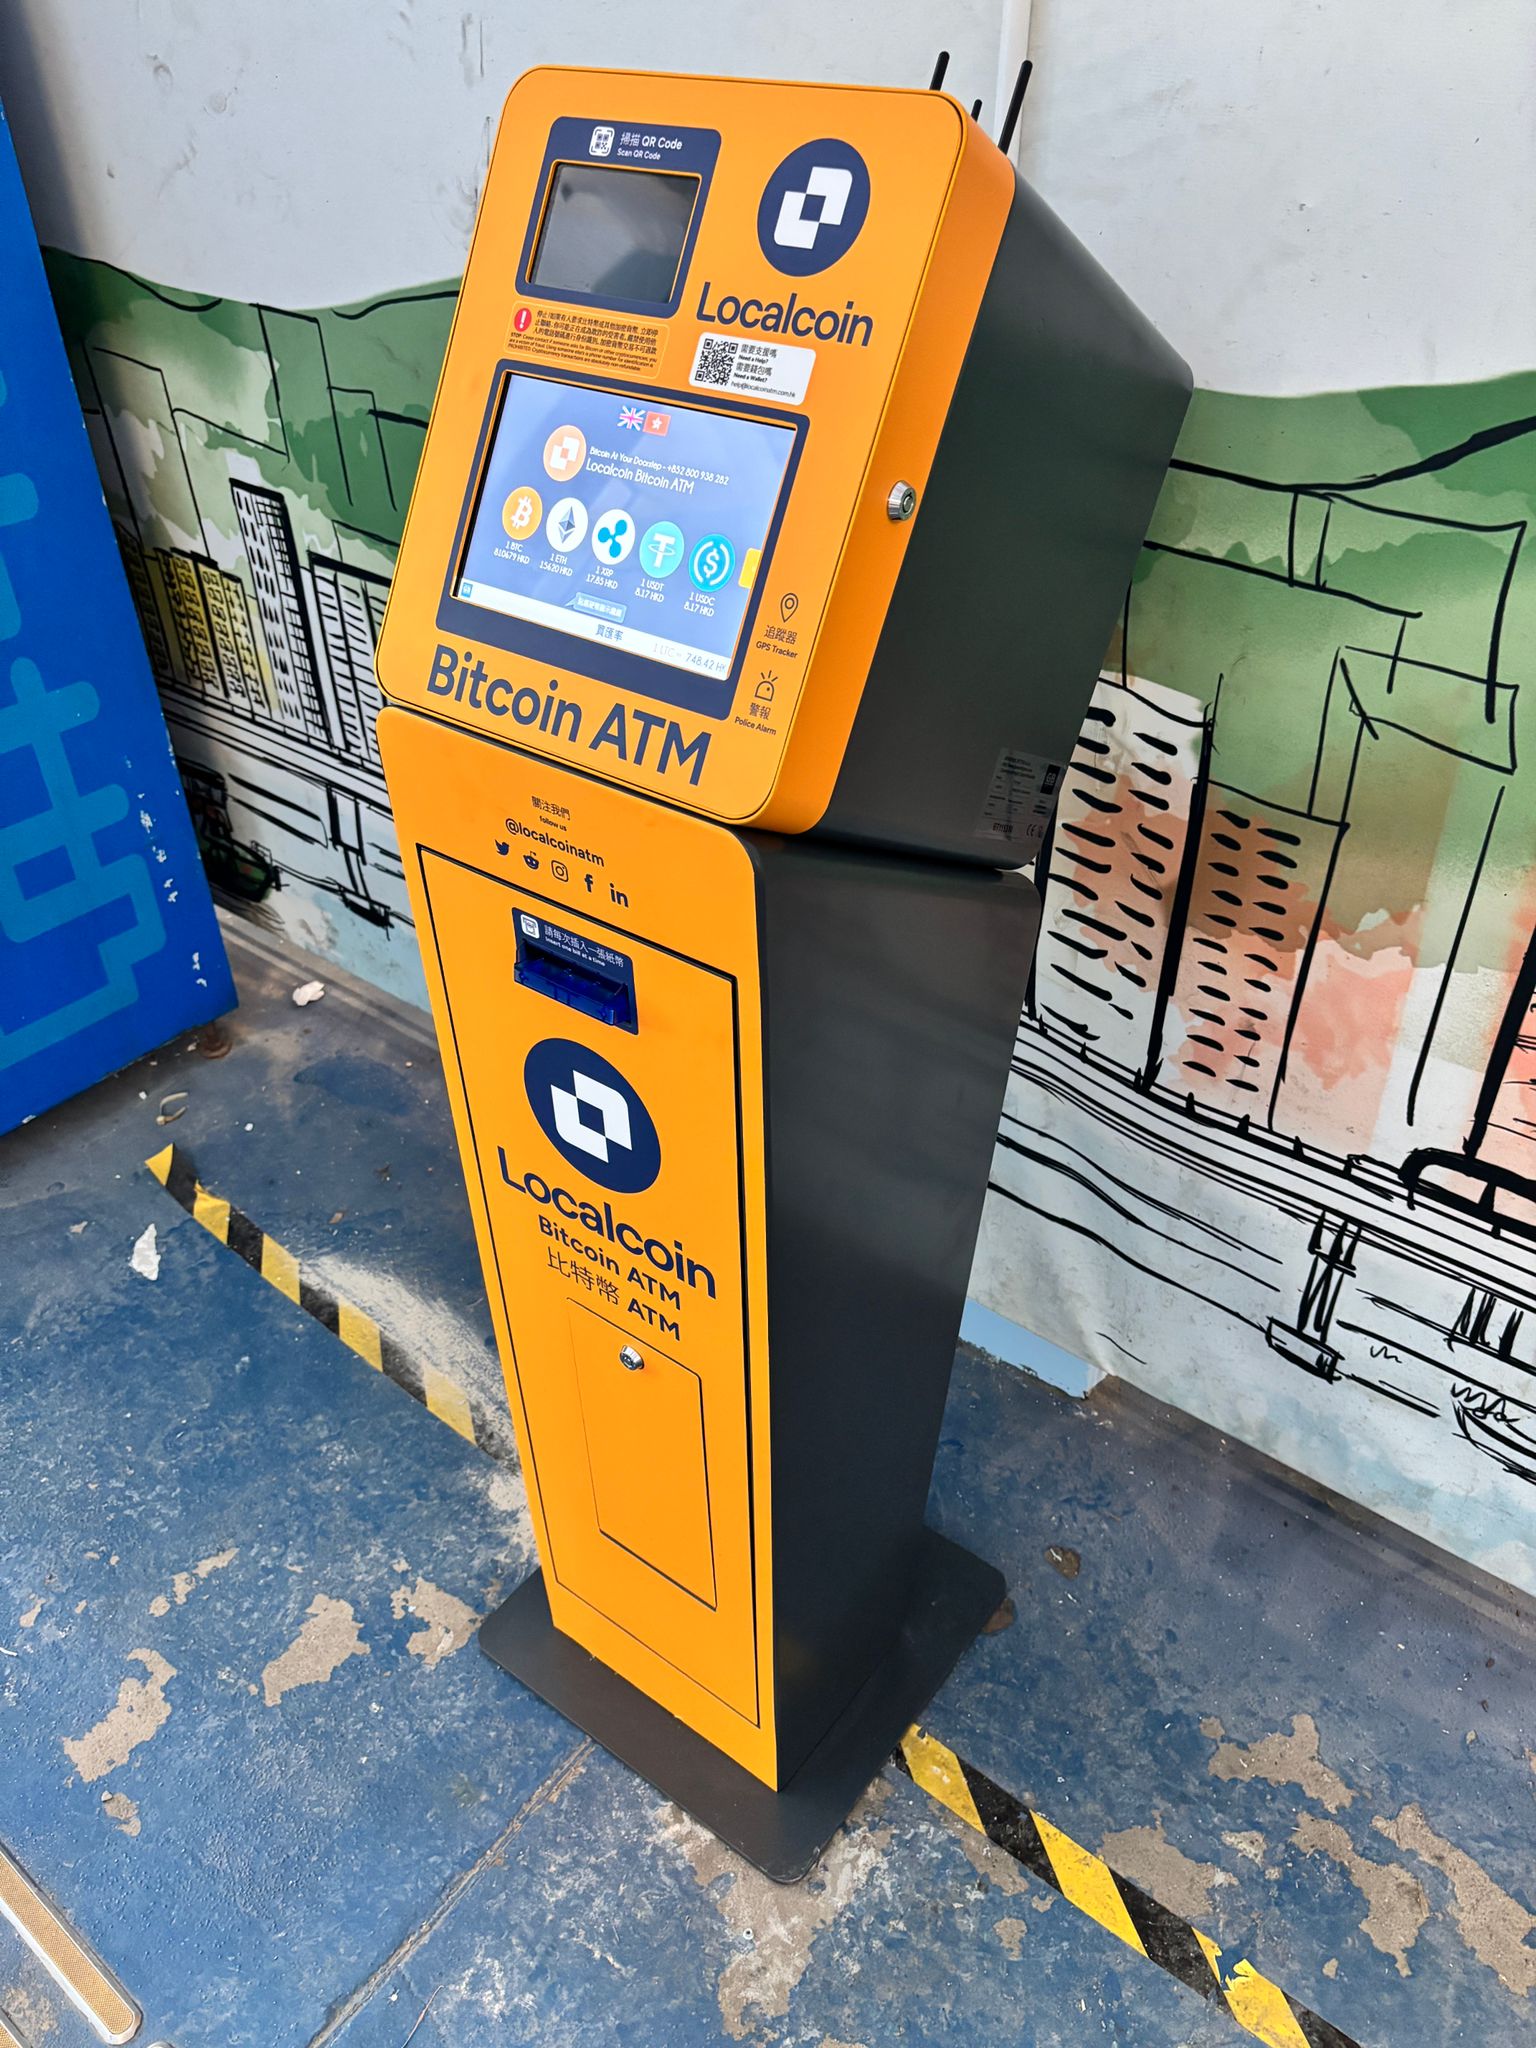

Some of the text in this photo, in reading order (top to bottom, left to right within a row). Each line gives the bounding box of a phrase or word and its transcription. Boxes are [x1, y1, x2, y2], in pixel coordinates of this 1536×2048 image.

[620, 132, 682, 150] 掃描 QR Code
[617, 148, 661, 160] Scan QR Code
[696, 281, 873, 347] Localcoin
[741, 344, 778, 358] 需要支援嗎
[755, 356, 768, 364] Help?
[590, 446, 610, 458] Bitcoin
[611, 451, 619, 460] At
[620, 453, 633, 463] Your
[634, 457, 662, 471] Doorstep
[667, 464, 685, 476] +852
[685, 468, 699, 478] 800
[700, 472, 713, 482] 938
[715, 475, 729, 485] 282
[586, 458, 695, 495] Localcoin Bitcoin ATM
[505, 541, 523, 552] 1 BTC
[517, 554, 530, 565] HKD
[550, 553, 567, 565] 1 ETH
[559, 566, 573, 576] HKD
[595, 566, 614, 577] 1 XRP
[604, 578, 618, 590] HKD
[640, 578, 664, 592] 1 USDT
[650, 591, 664, 602] HKD
[689, 592, 715, 606] 1 USDC
[700, 605, 715, 617] HKD
[764, 625, 797, 645] 追蹤器
[756, 641, 798, 658] GPS Tracker
[426, 644, 712, 786] Bitcoin ATM
[750, 702, 771, 720] 警報
[735, 716, 776, 735] Police Alarm
[532, 796, 570, 820] 關注我們
[540, 816, 558, 828] follow
[506, 818, 604, 867] @localcoinatm
[544, 925, 624, 967] 請每次插入一張紙幣
[545, 937, 561, 947] Insert
[572, 948, 580, 956] bill
[593, 957, 605, 966] time
[498, 1146, 715, 1298] Localcoin
[538, 1214, 682, 1310] Bitcoin ATM
[547, 1245, 681, 1340] 比特幣 ATM
